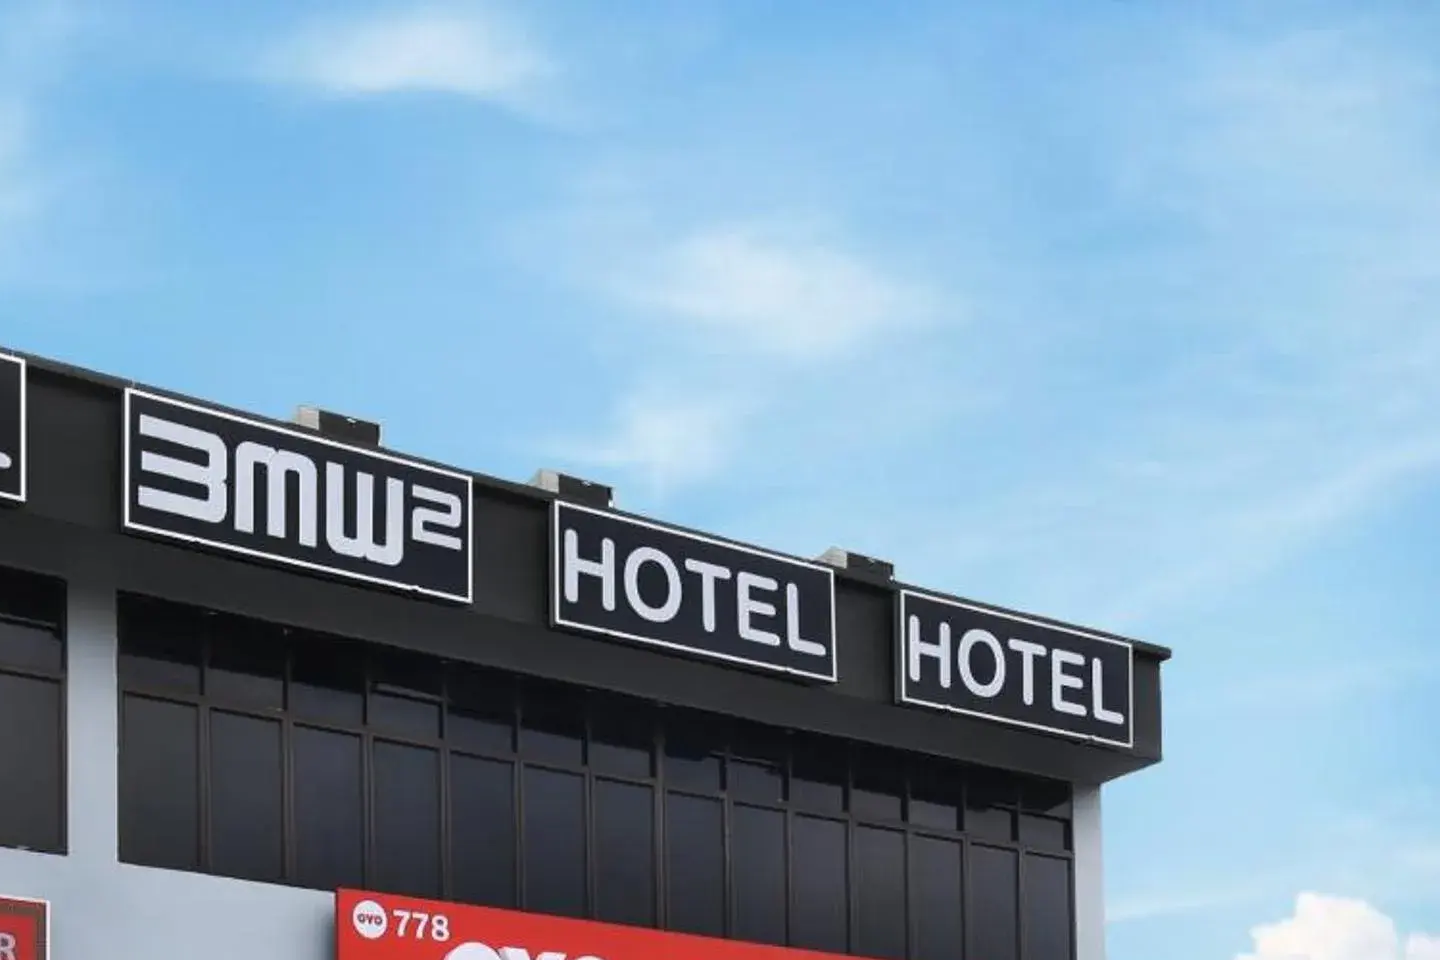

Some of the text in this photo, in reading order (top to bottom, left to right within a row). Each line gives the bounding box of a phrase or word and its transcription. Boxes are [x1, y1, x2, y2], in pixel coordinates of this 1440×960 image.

[564, 528, 827, 657] HOTEL
[908, 614, 1125, 725] HOTEL
[357, 909, 451, 942] OYO 778
